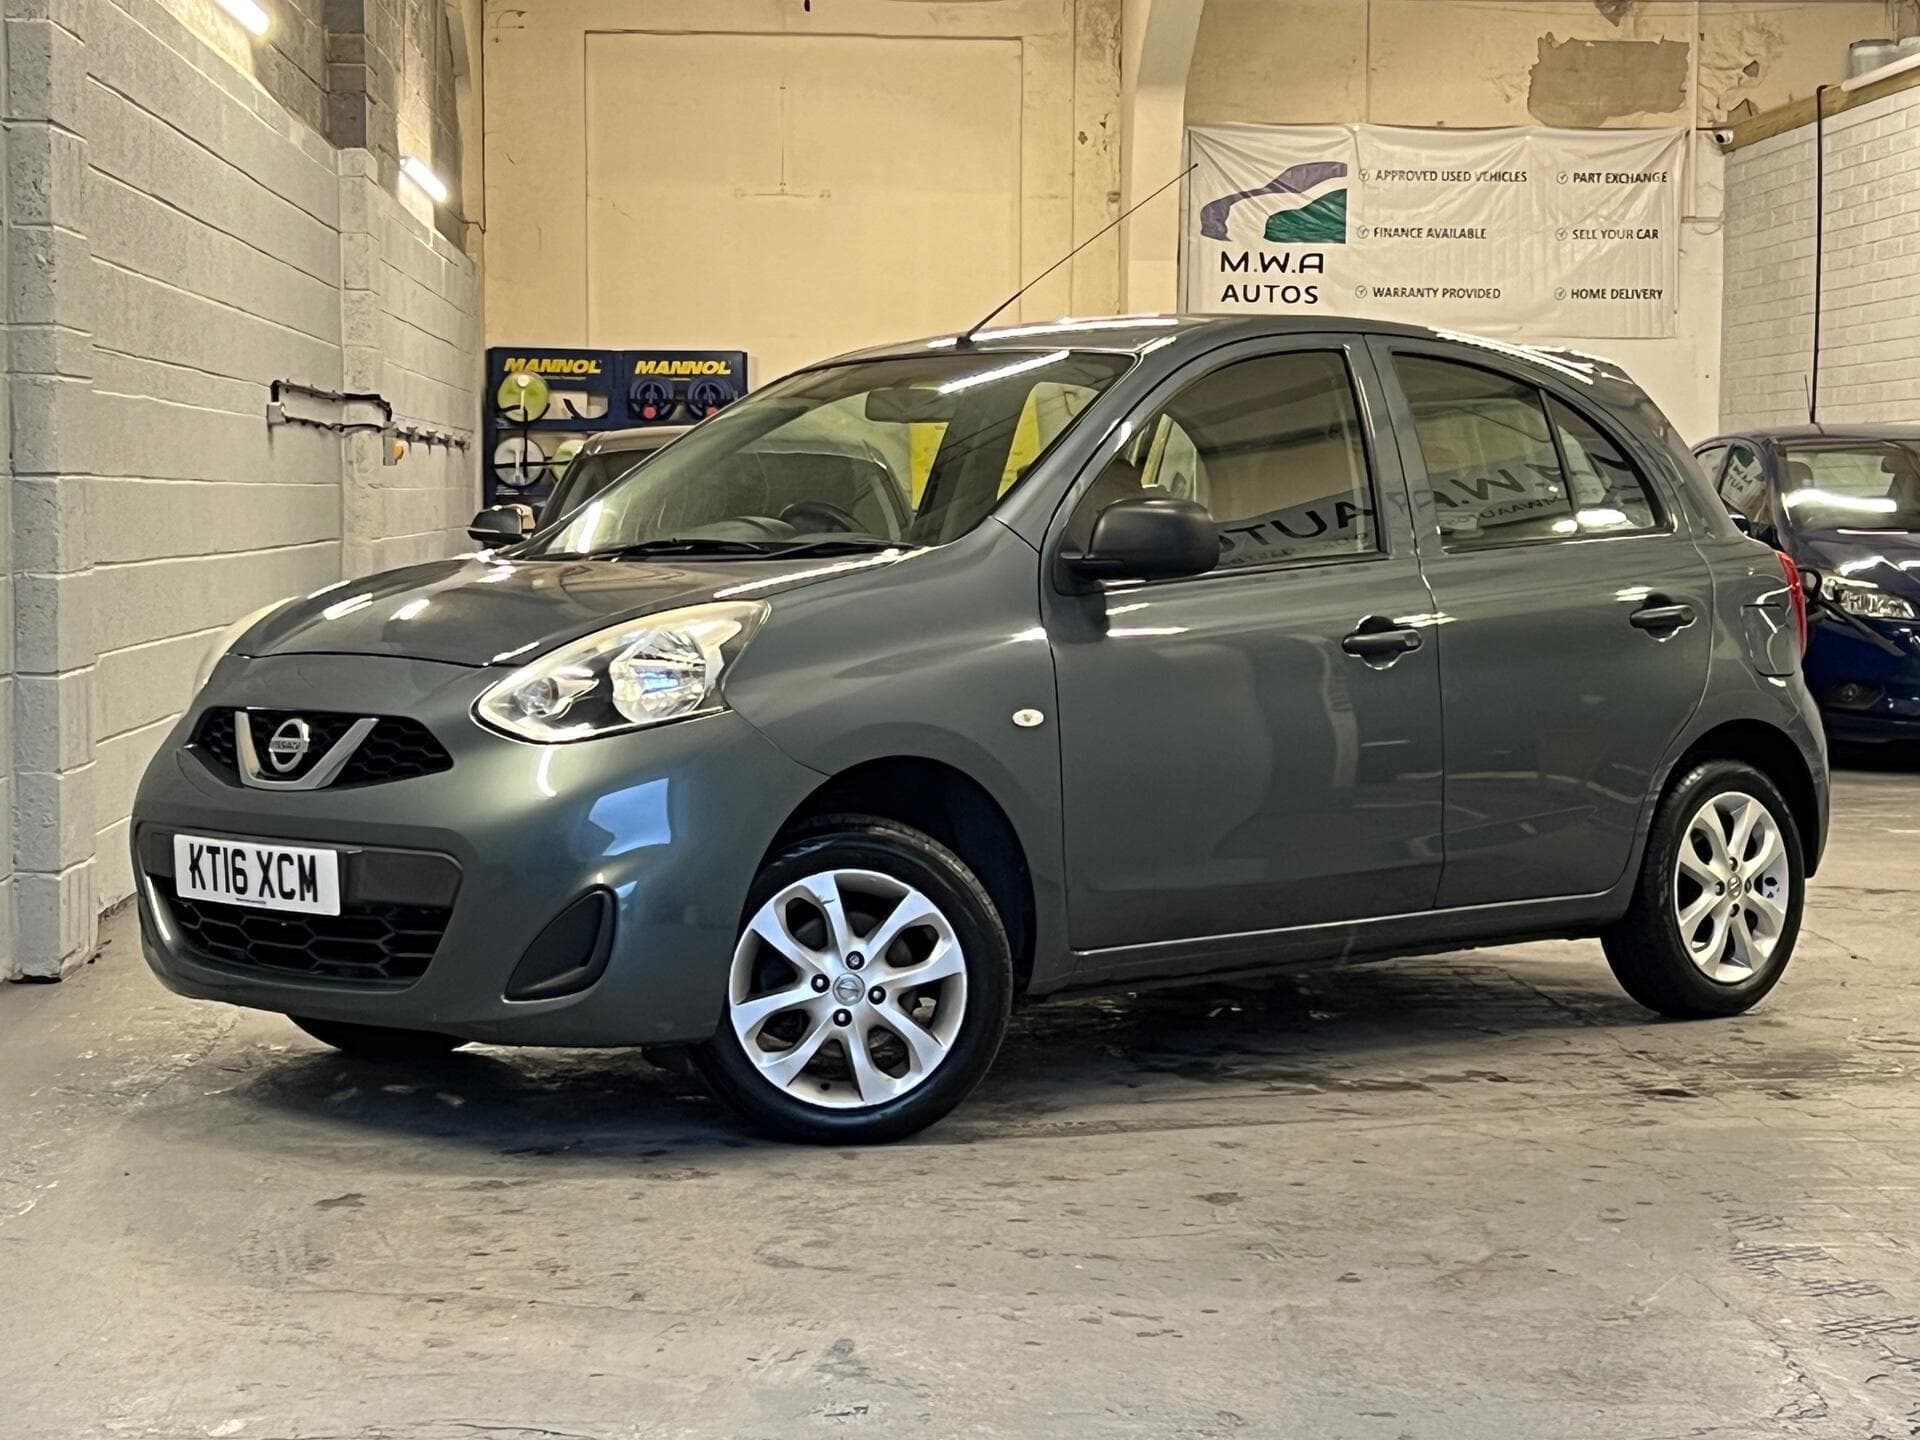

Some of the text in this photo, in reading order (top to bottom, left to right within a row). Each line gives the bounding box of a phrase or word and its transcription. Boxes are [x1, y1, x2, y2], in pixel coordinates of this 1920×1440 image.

[1376, 170, 1528, 183] APPROVED USED VEHICLES
[1573, 171, 1667, 184] PART EXCHANGE
[1373, 227, 1487, 240] FINANCE AVAILABLE
[1572, 228, 1660, 240] SELL YOUR CAR
[1220, 250, 1324, 274] M.W.A
[1220, 283, 1319, 305] AUTOS
[1372, 287, 1501, 299] WARRANTY PROVIDED
[1570, 288, 1664, 300] HOME DELIVERY
[503, 358, 602, 374] MANNOL
[634, 360, 732, 375] MANNOL
[188, 843, 319, 903] KT16 XCM
